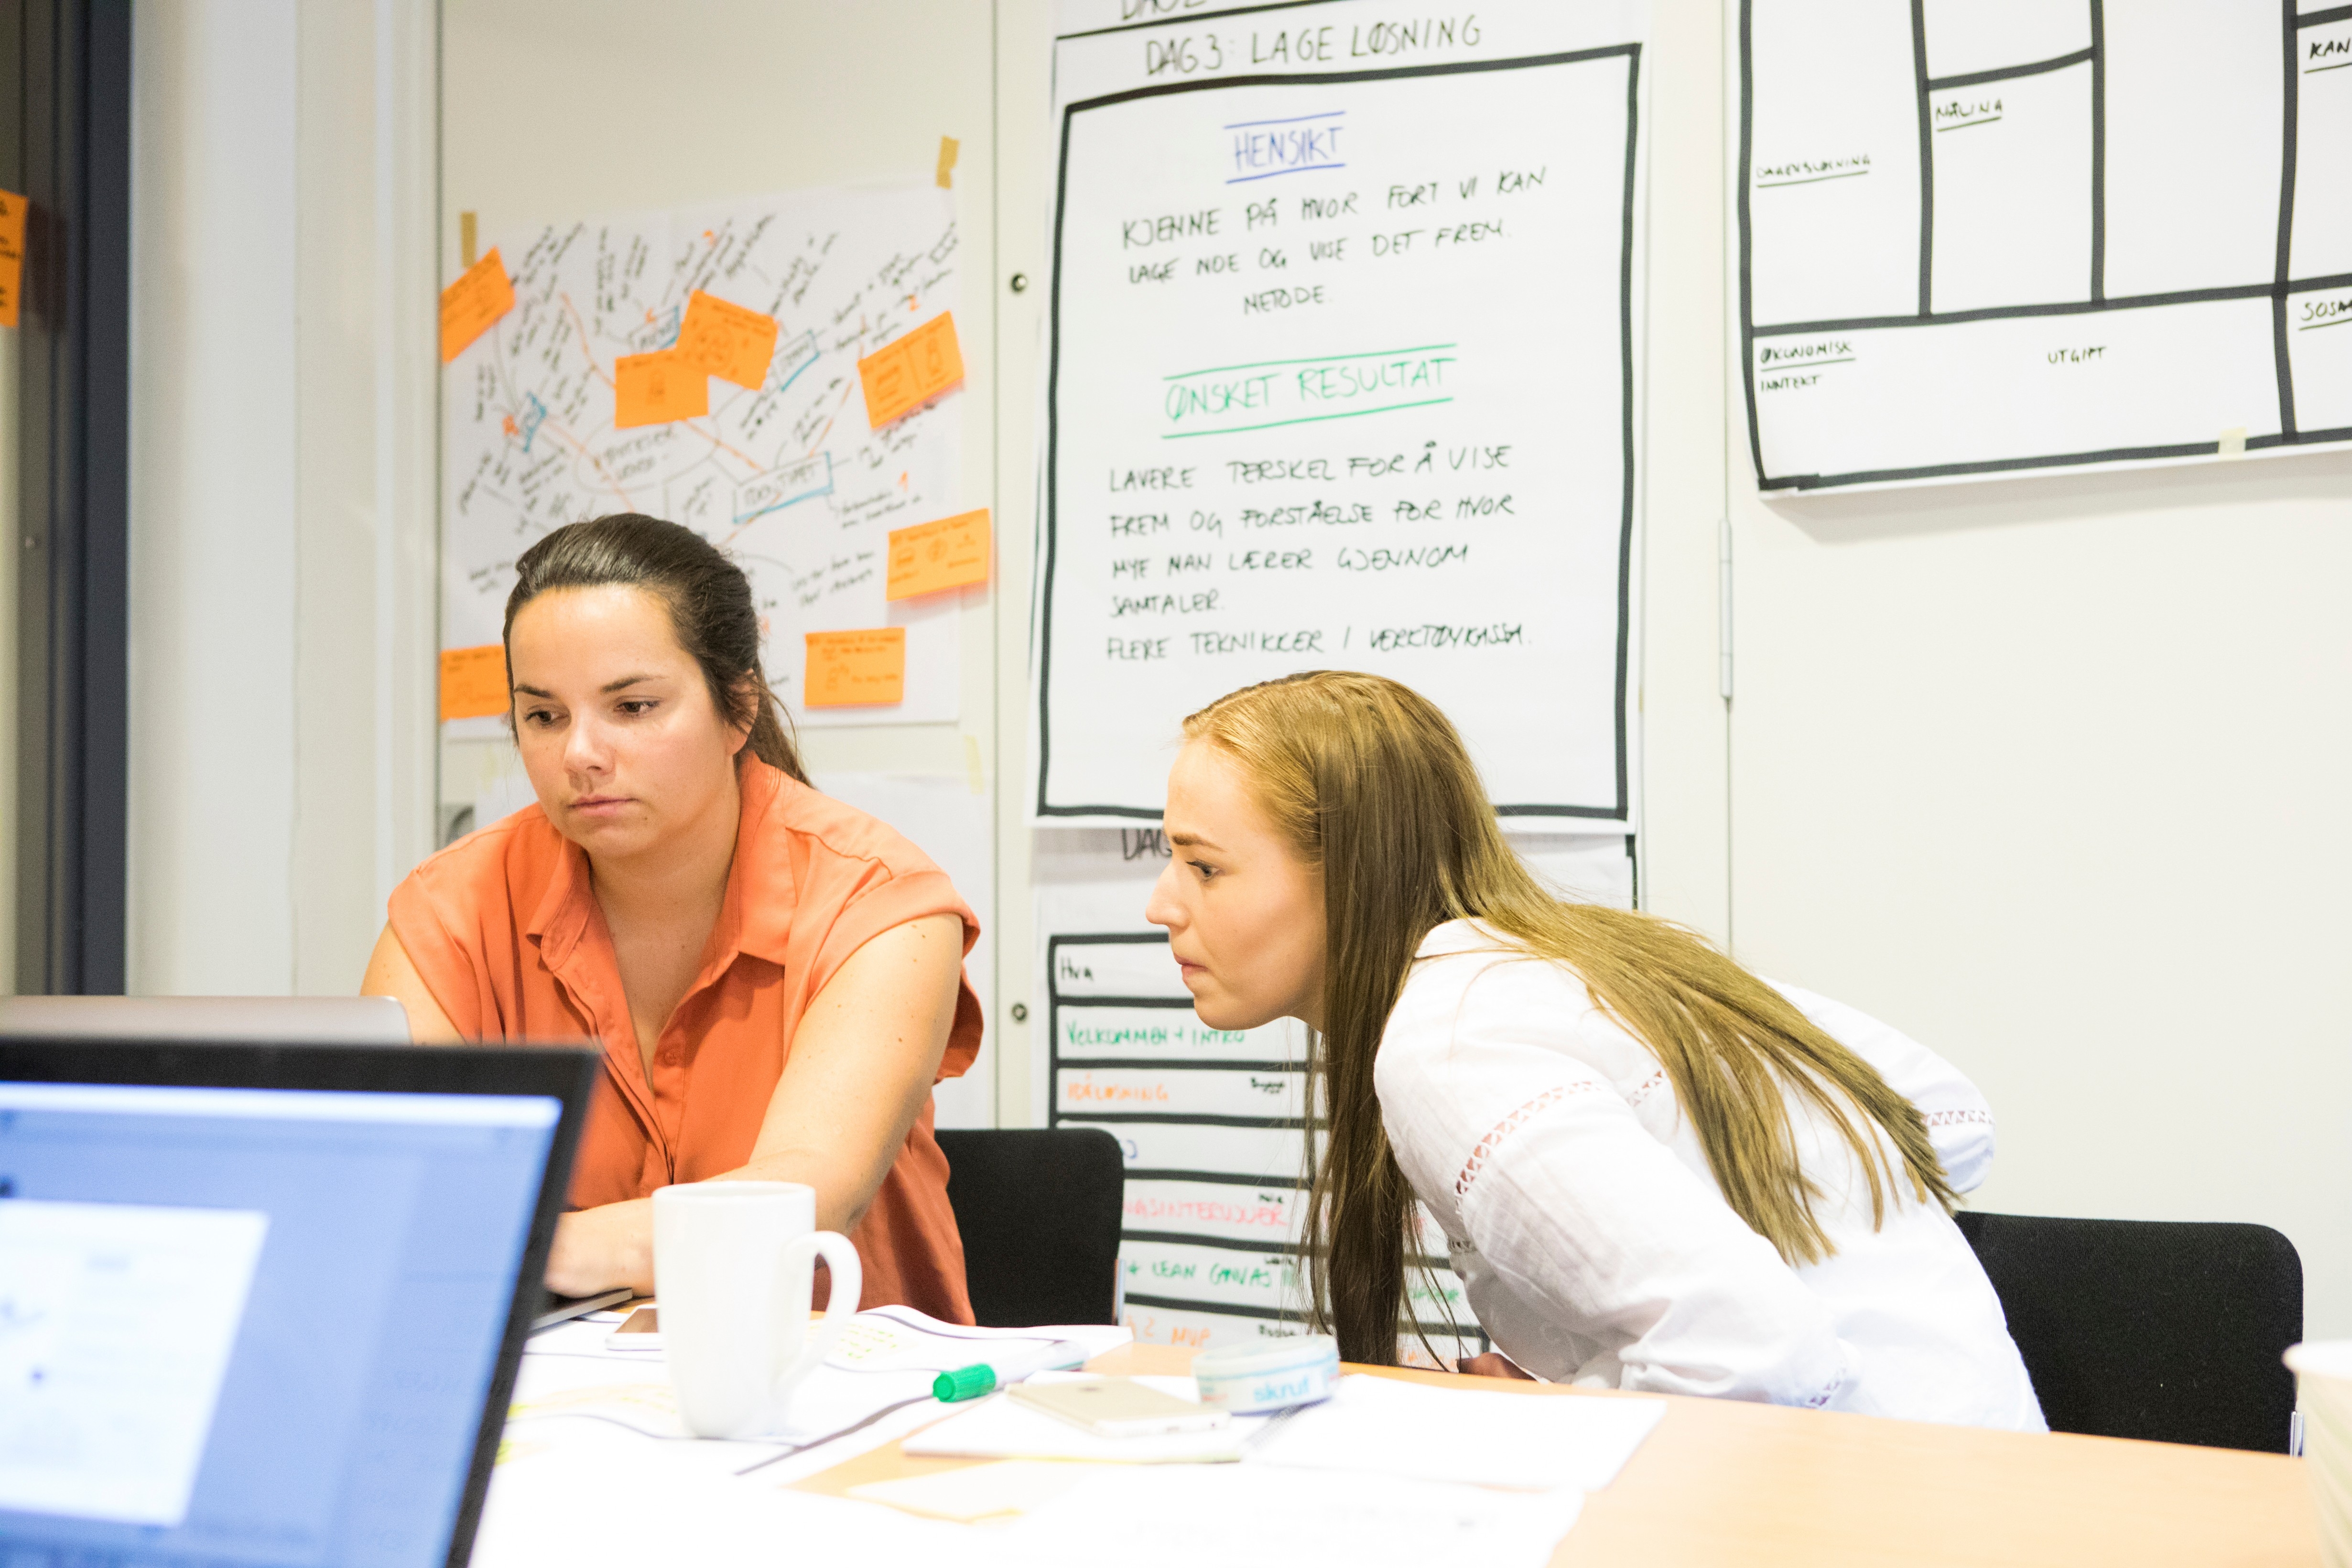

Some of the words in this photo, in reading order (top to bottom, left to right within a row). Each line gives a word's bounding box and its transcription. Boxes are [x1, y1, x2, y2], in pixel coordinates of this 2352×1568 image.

[1251, 26, 1334, 65] LAGE
[1350, 14, 1481, 57] LØSNING
[1234, 126, 1344, 171] HENSIKT
[1122, 208, 1222, 250] KJENNE
[1246, 198, 1277, 231] PÅ
[1387, 182, 1438, 209] FORT
[1458, 176, 1478, 200] VI
[1497, 166, 1547, 195] KAN
[1128, 258, 1180, 284] LAGE
[1196, 253, 1240, 276] NOE
[1258, 248, 1287, 270] OG
[1310, 238, 1348, 262] VISE
[1372, 229, 1426, 257] DET
[1165, 373, 1281, 422] ØNSKET
[1297, 357, 1458, 403] RESULTAT
[1109, 466, 1197, 493] LAVERE
[1226, 459, 1337, 484] TERSKEL
[1347, 453, 1405, 477] FOR
[1415, 441, 1437, 473] Å
[1448, 445, 1513, 470] VISE
[1109, 513, 1170, 538] FREM
[1189, 510, 1224, 538] OG
[1240, 500, 1374, 531] FORSTÅELSE
[1393, 499, 1442, 522] FOR
[1228, 549, 1313, 571] LÆRER
[1338, 544, 1469, 571] GJENNOM
[1107, 636, 1171, 661] FLERE
[1190, 630, 1325, 656] TEKNIKKER
[1192, 1029, 1245, 1047] INTRO
[1151, 1259, 1197, 1280] LEAN
